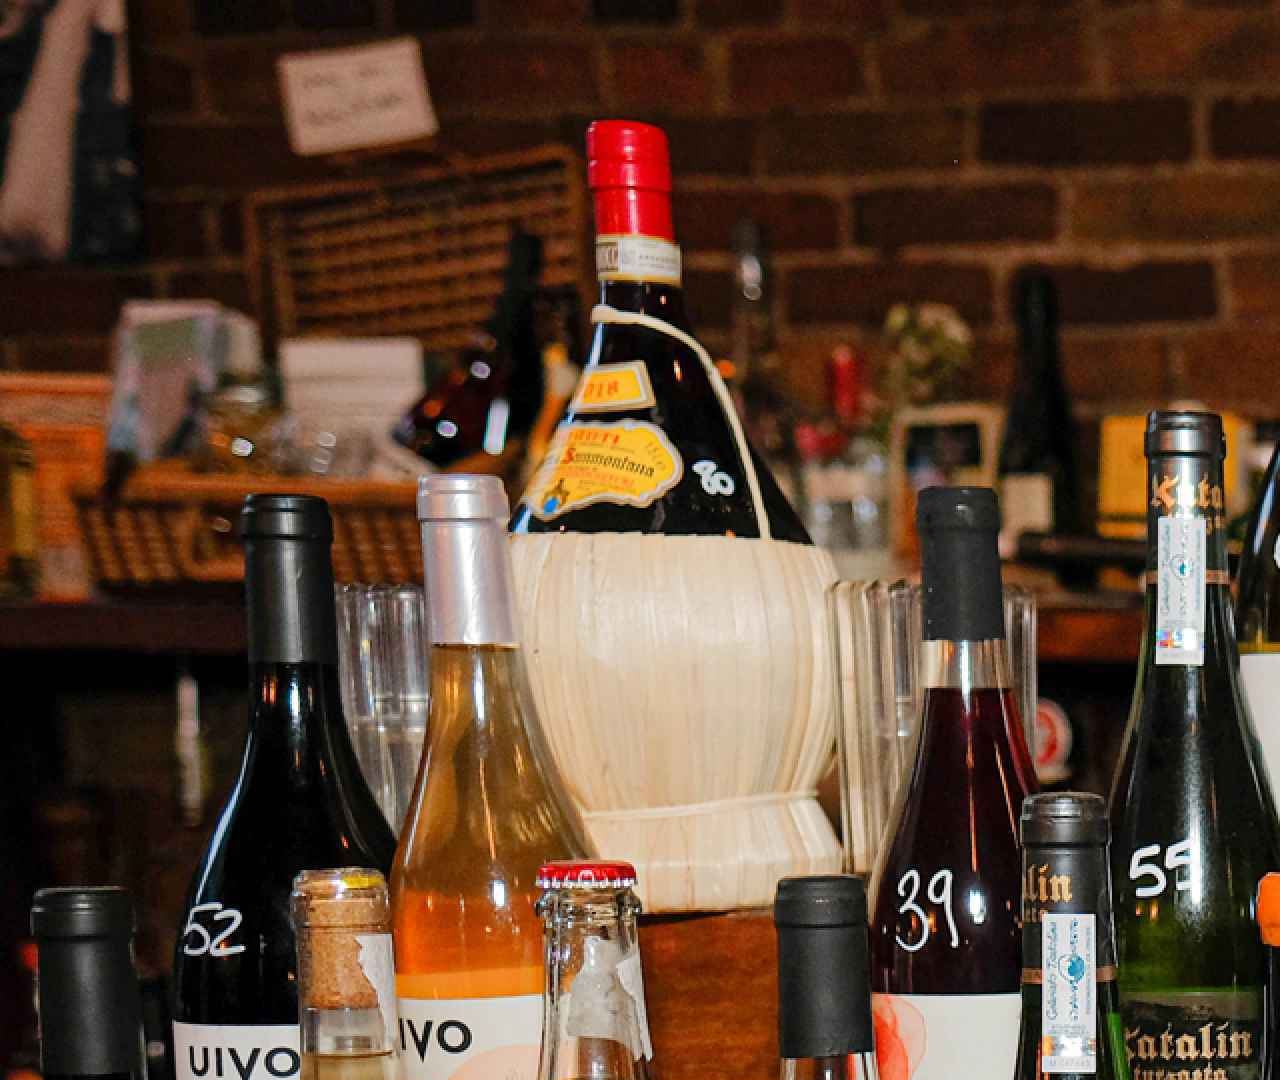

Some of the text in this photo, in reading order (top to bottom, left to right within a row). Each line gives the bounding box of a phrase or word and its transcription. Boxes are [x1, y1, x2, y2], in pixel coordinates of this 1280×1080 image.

[183, 902, 247, 956] 52
[895, 868, 959, 952] 39
[401, 1018, 473, 1063] IVO
